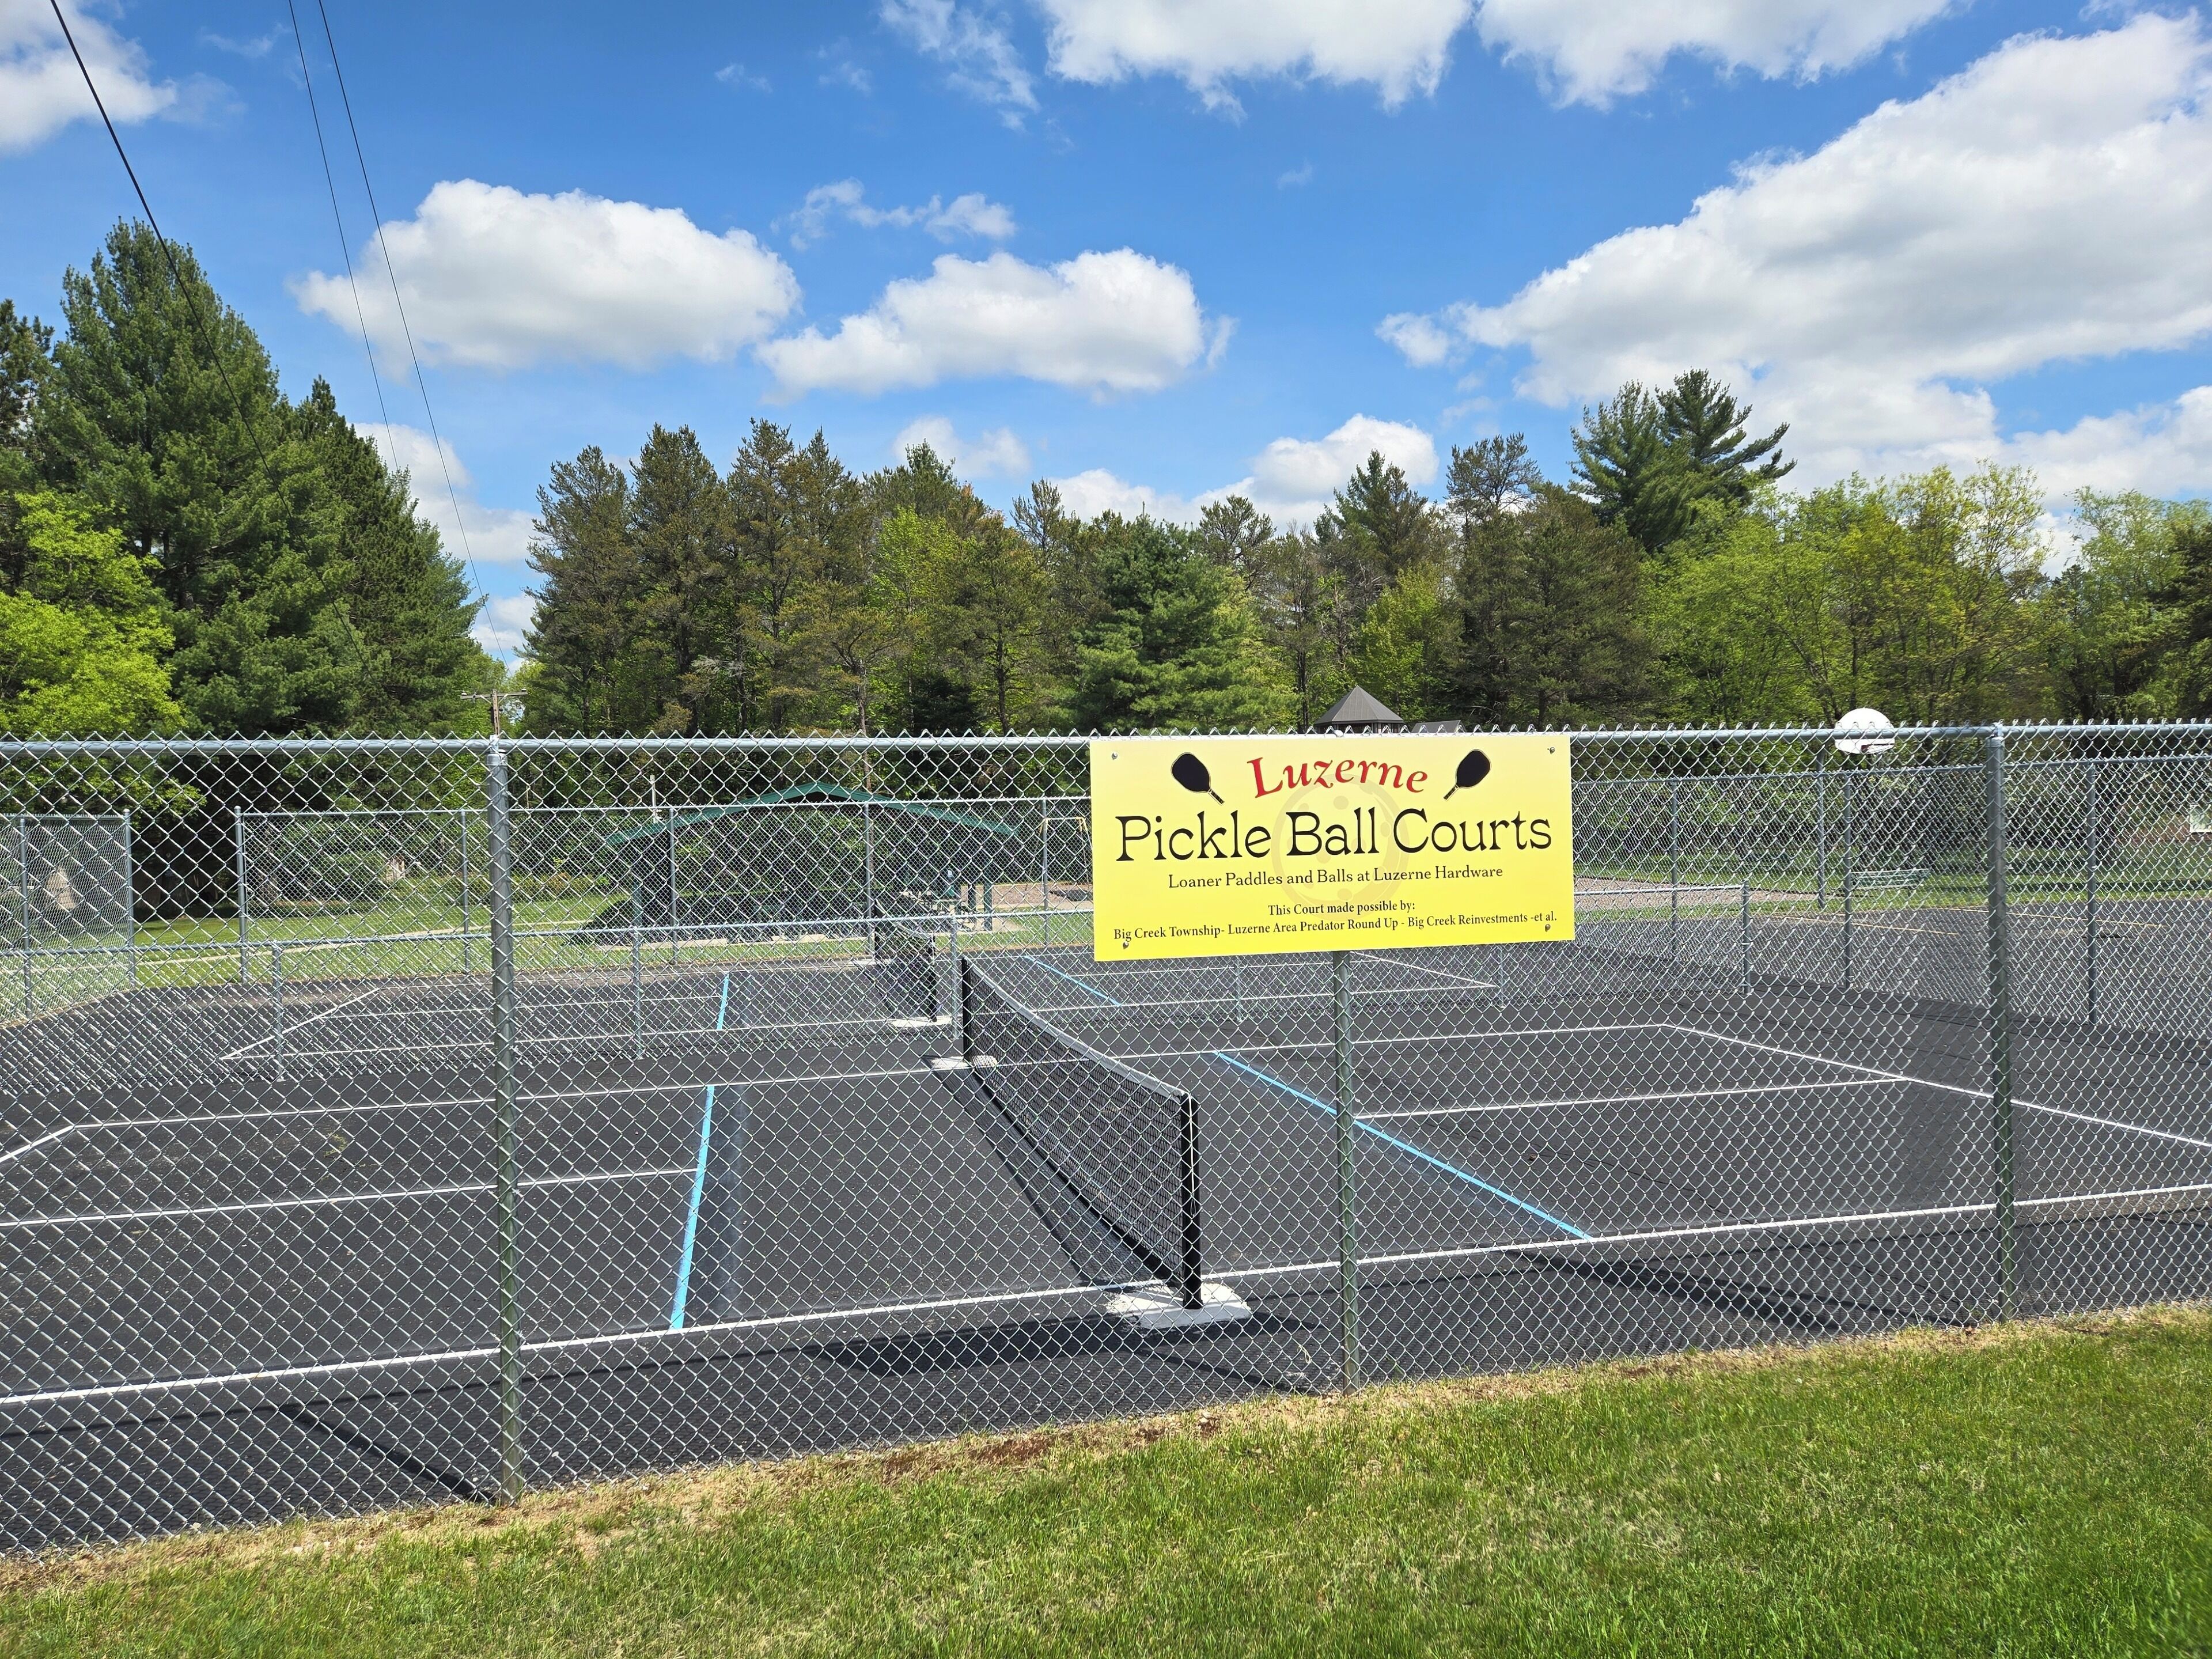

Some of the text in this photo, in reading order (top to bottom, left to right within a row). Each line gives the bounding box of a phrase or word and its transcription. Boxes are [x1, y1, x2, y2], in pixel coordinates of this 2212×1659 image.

[1247, 757, 1428, 798] Luzerne
[1115, 806, 1552, 862] Pickle Ball Courts
[1168, 864, 1503, 888] Loaner Paddles and Balls at Luzerne Hardware
[1267, 899, 1415, 915] This Court made possible by:
[1114, 929, 1132, 942] Big
[1134, 926, 1166, 938] Creek
[1169, 925, 1225, 938] Township-
[1228, 924, 1270, 934] Luzerne
[1273, 922, 1297, 933] Area
[1300, 920, 1345, 931] Predator
[1347, 918, 1381, 930] Round
[1384, 918, 1399, 931] Up
[1408, 916, 1425, 930] Big
[1426, 915, 1456, 926] Creek
[1458, 913, 1528, 925] Reinvestments
[1531, 912, 1543, 922] -et
[1545, 910, 1557, 921] al.
